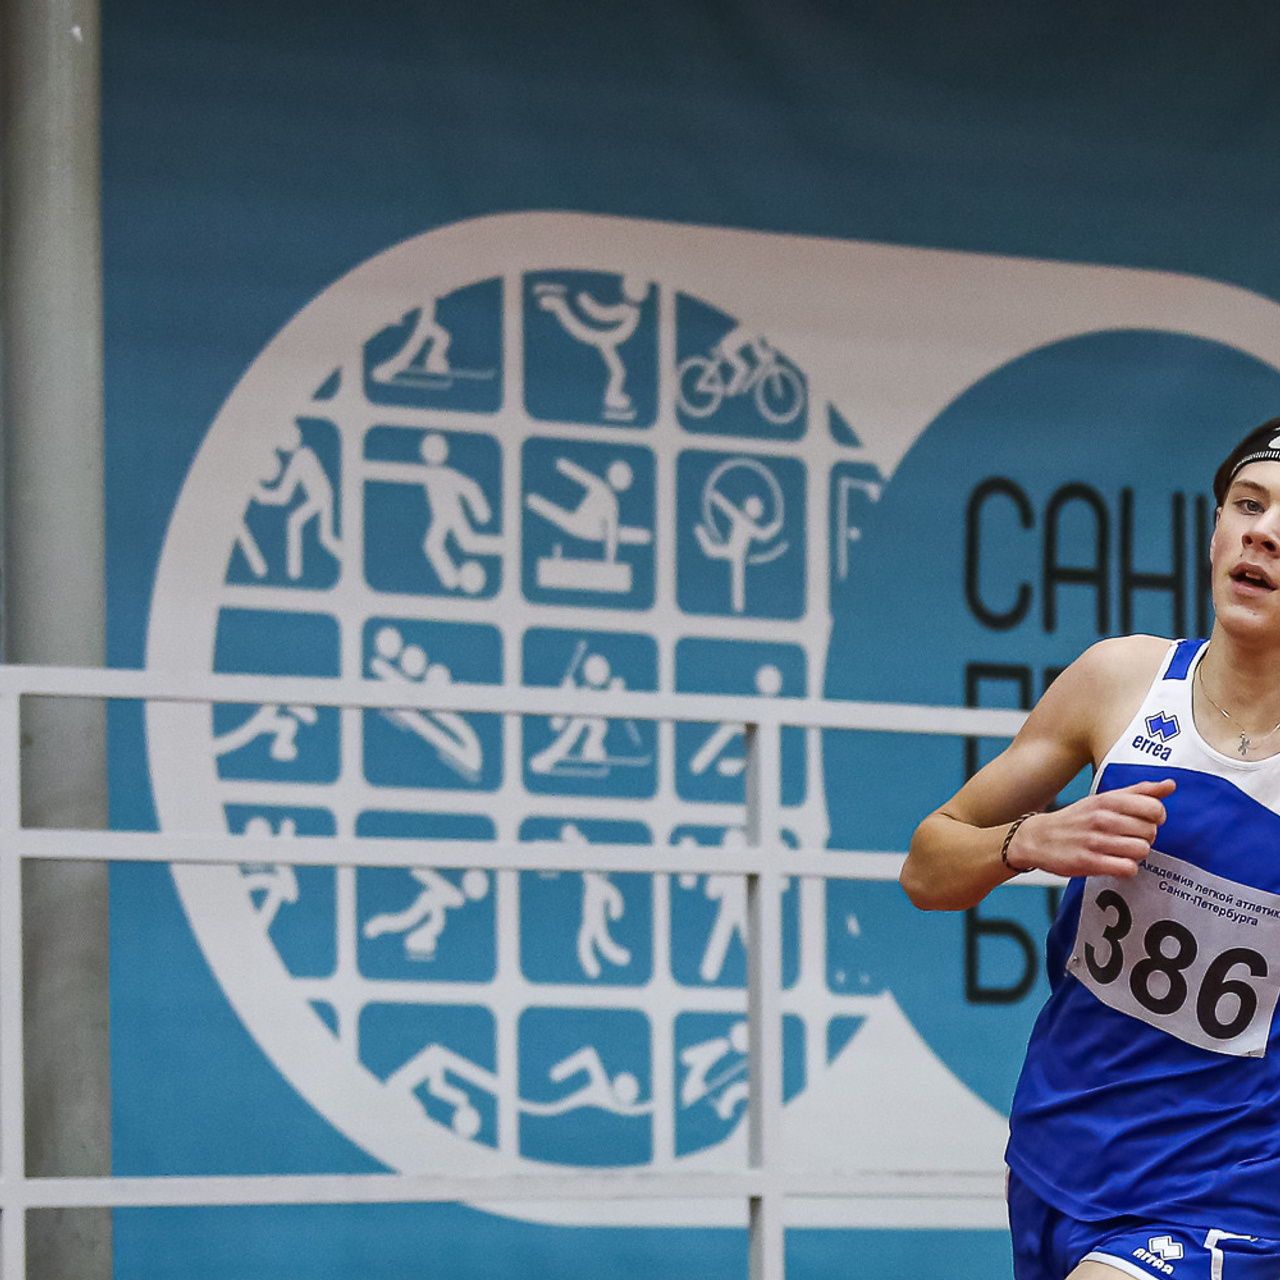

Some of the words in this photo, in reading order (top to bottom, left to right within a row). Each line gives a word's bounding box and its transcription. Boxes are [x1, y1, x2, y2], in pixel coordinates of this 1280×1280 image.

[965, 476, 1212, 638] САН
[1132, 735, 1172, 761] errea
[1139, 859, 1194, 888] Академия
[1195, 883, 1233, 905] легкой
[1158, 881, 1259, 926] Санкт-Петербурга
[1084, 889, 1269, 1040] 386
